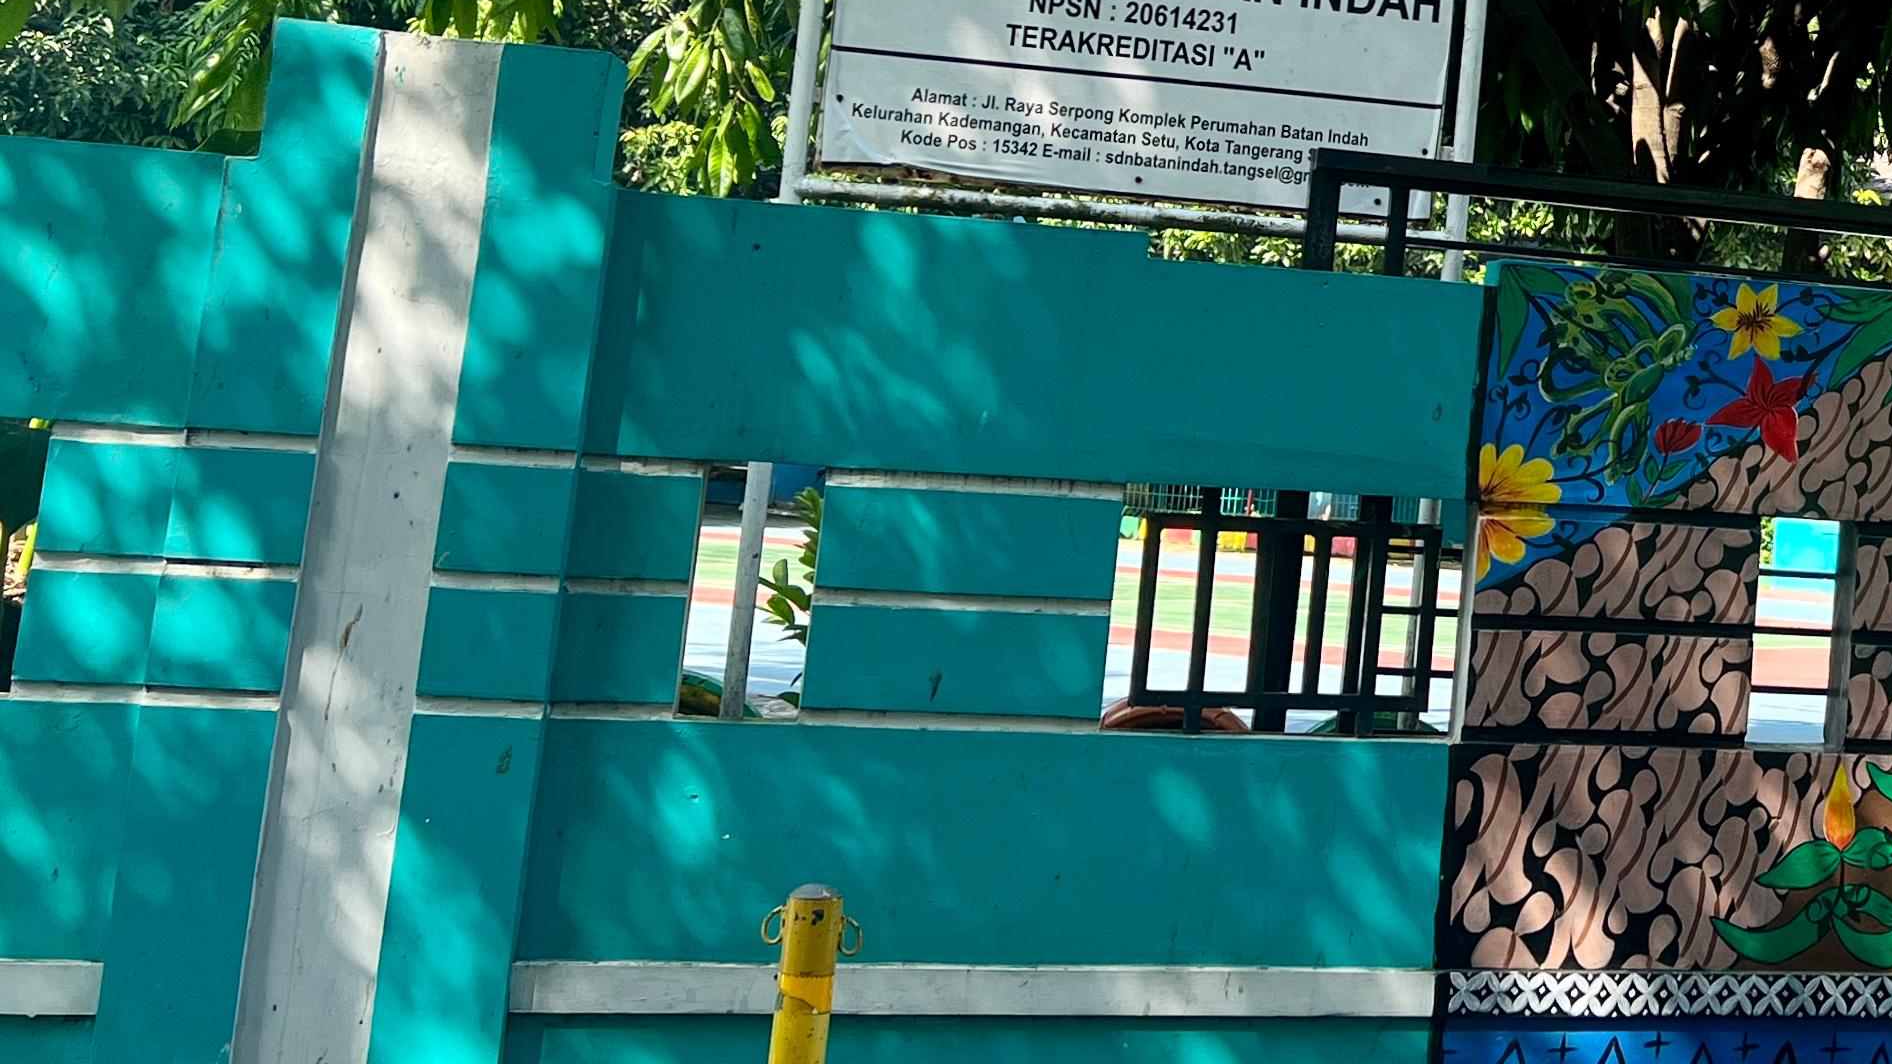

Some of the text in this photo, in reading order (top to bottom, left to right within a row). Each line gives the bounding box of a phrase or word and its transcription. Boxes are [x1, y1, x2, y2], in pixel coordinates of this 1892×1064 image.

[1124, 1, 1237, 34] 20614231
[1006, 24, 1265, 71] TERAKREDITASI "A"
[852, 103, 932, 124] Kelurahan
[939, 112, 1044, 138] Kademangan,
[1051, 124, 1136, 144] Kecamatan
[1142, 132, 1179, 151] Setu,
[1185, 136, 1219, 152] Kota
[1225, 140, 1302, 164] Tangerang
[911, 88, 968, 107] Alamat
[981, 95, 999, 110] Jl.
[1005, 97, 1043, 116] Raya
[1049, 102, 1113, 124] Serpong
[1119, 108, 1186, 129] Komplek
[1191, 116, 1275, 137] Perumahan
[1281, 125, 1323, 141] Batan
[1328, 129, 1368, 146] Indah
[901, 129, 941, 147] Kode
[947, 135, 976, 150] Pos
[993, 139, 1038, 156] 15342
[1042, 144, 1091, 161] E-mail
